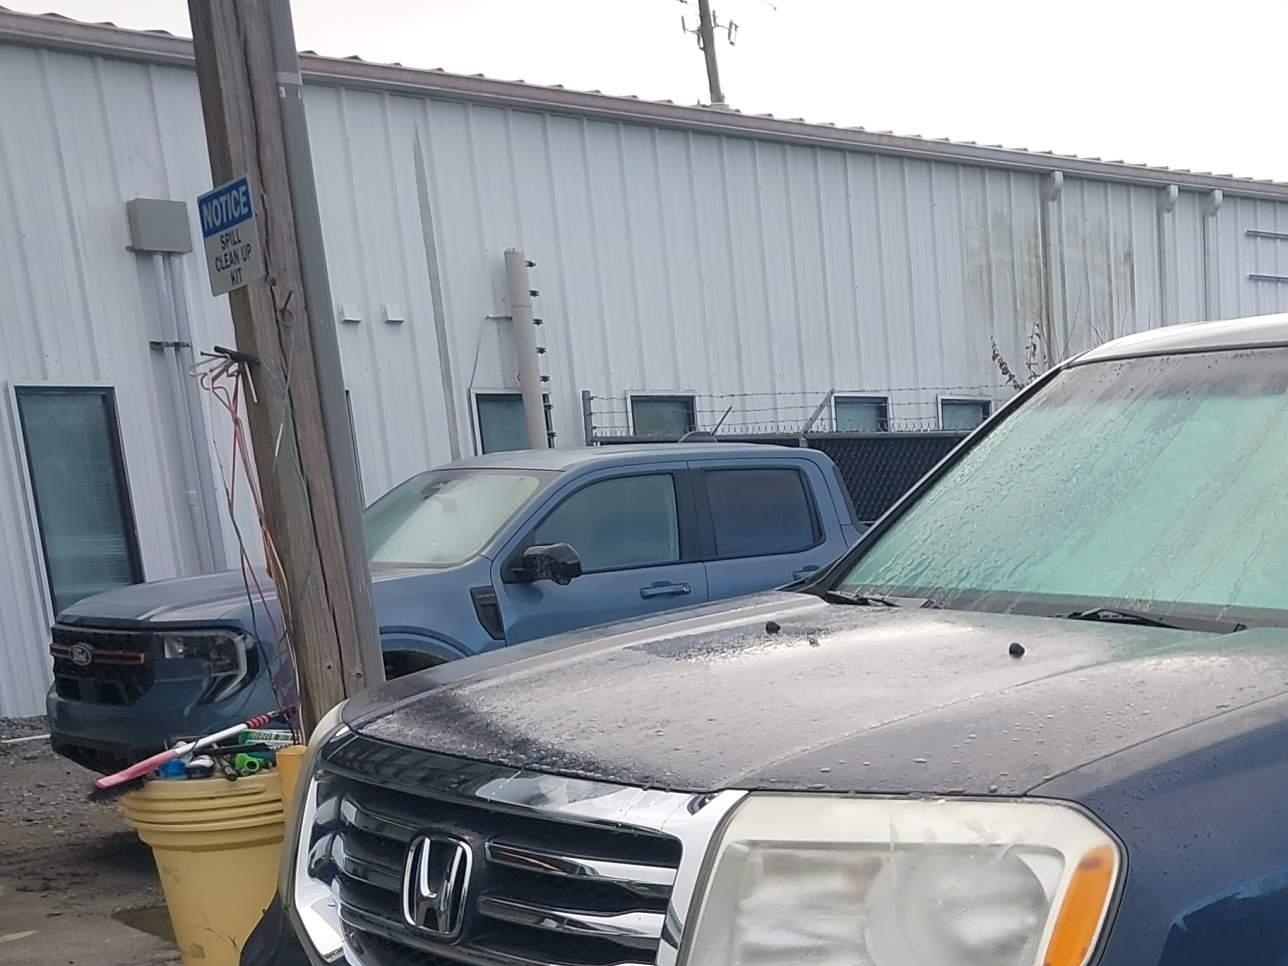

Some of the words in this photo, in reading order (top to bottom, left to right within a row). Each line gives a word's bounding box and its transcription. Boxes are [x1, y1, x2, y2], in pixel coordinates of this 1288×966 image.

[202, 185, 249, 231] NOTICE
[220, 228, 242, 250] SPILL
[215, 250, 240, 273] CLEAN
[241, 243, 252, 262] UP
[230, 267, 242, 286] KIT
